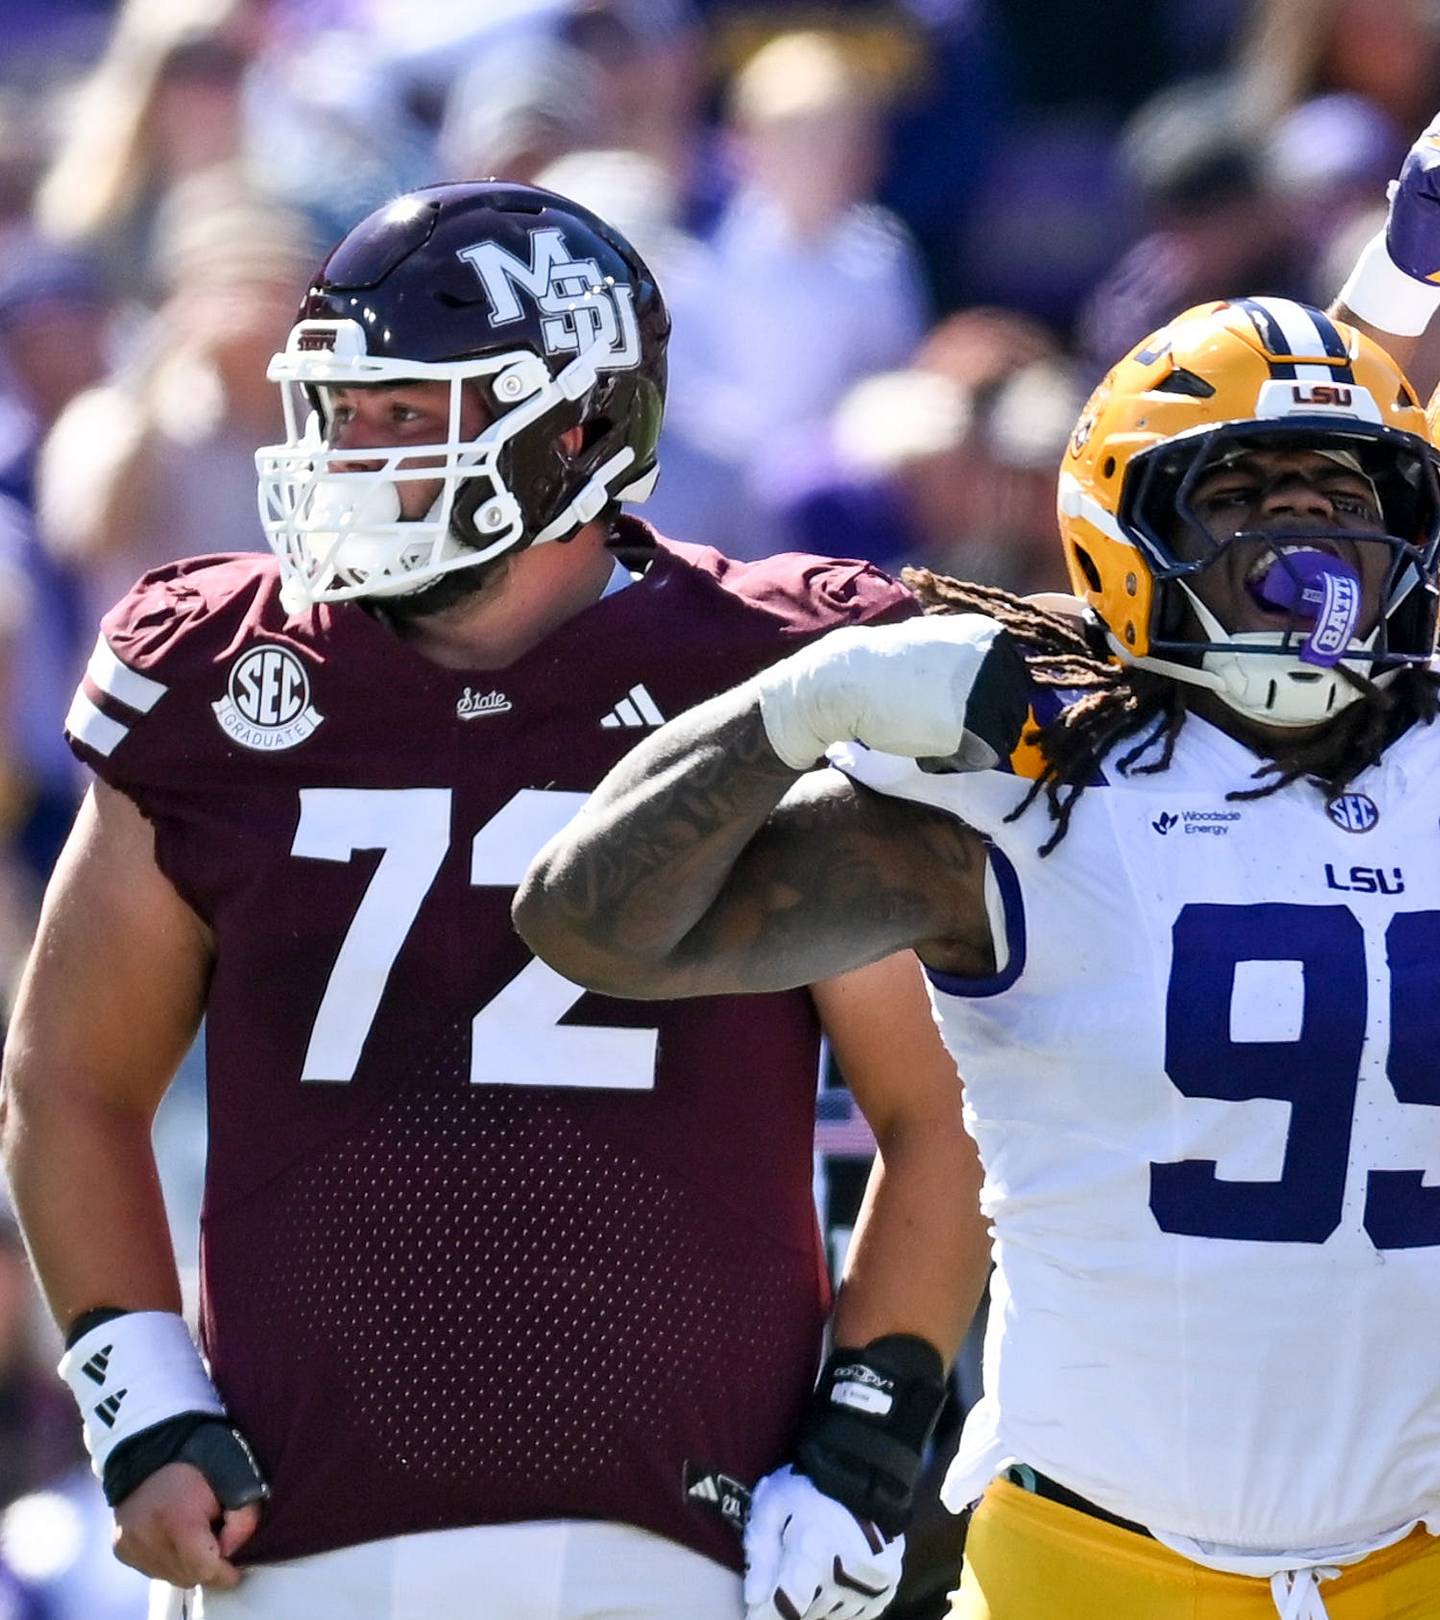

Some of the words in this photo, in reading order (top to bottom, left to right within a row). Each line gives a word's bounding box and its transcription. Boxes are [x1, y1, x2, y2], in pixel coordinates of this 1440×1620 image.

[456, 228, 643, 372] MSU
[1292, 386, 1352, 406] LSU
[237, 652, 302, 725] SEC
[457, 686, 512, 720] State
[223, 714, 307, 747] GRADUATE
[1181, 810, 1242, 822] Woodside
[1184, 824, 1229, 835] Energy
[1328, 795, 1378, 831] SEC
[1324, 863, 1405, 895] LSU
[290, 787, 659, 1090] 72
